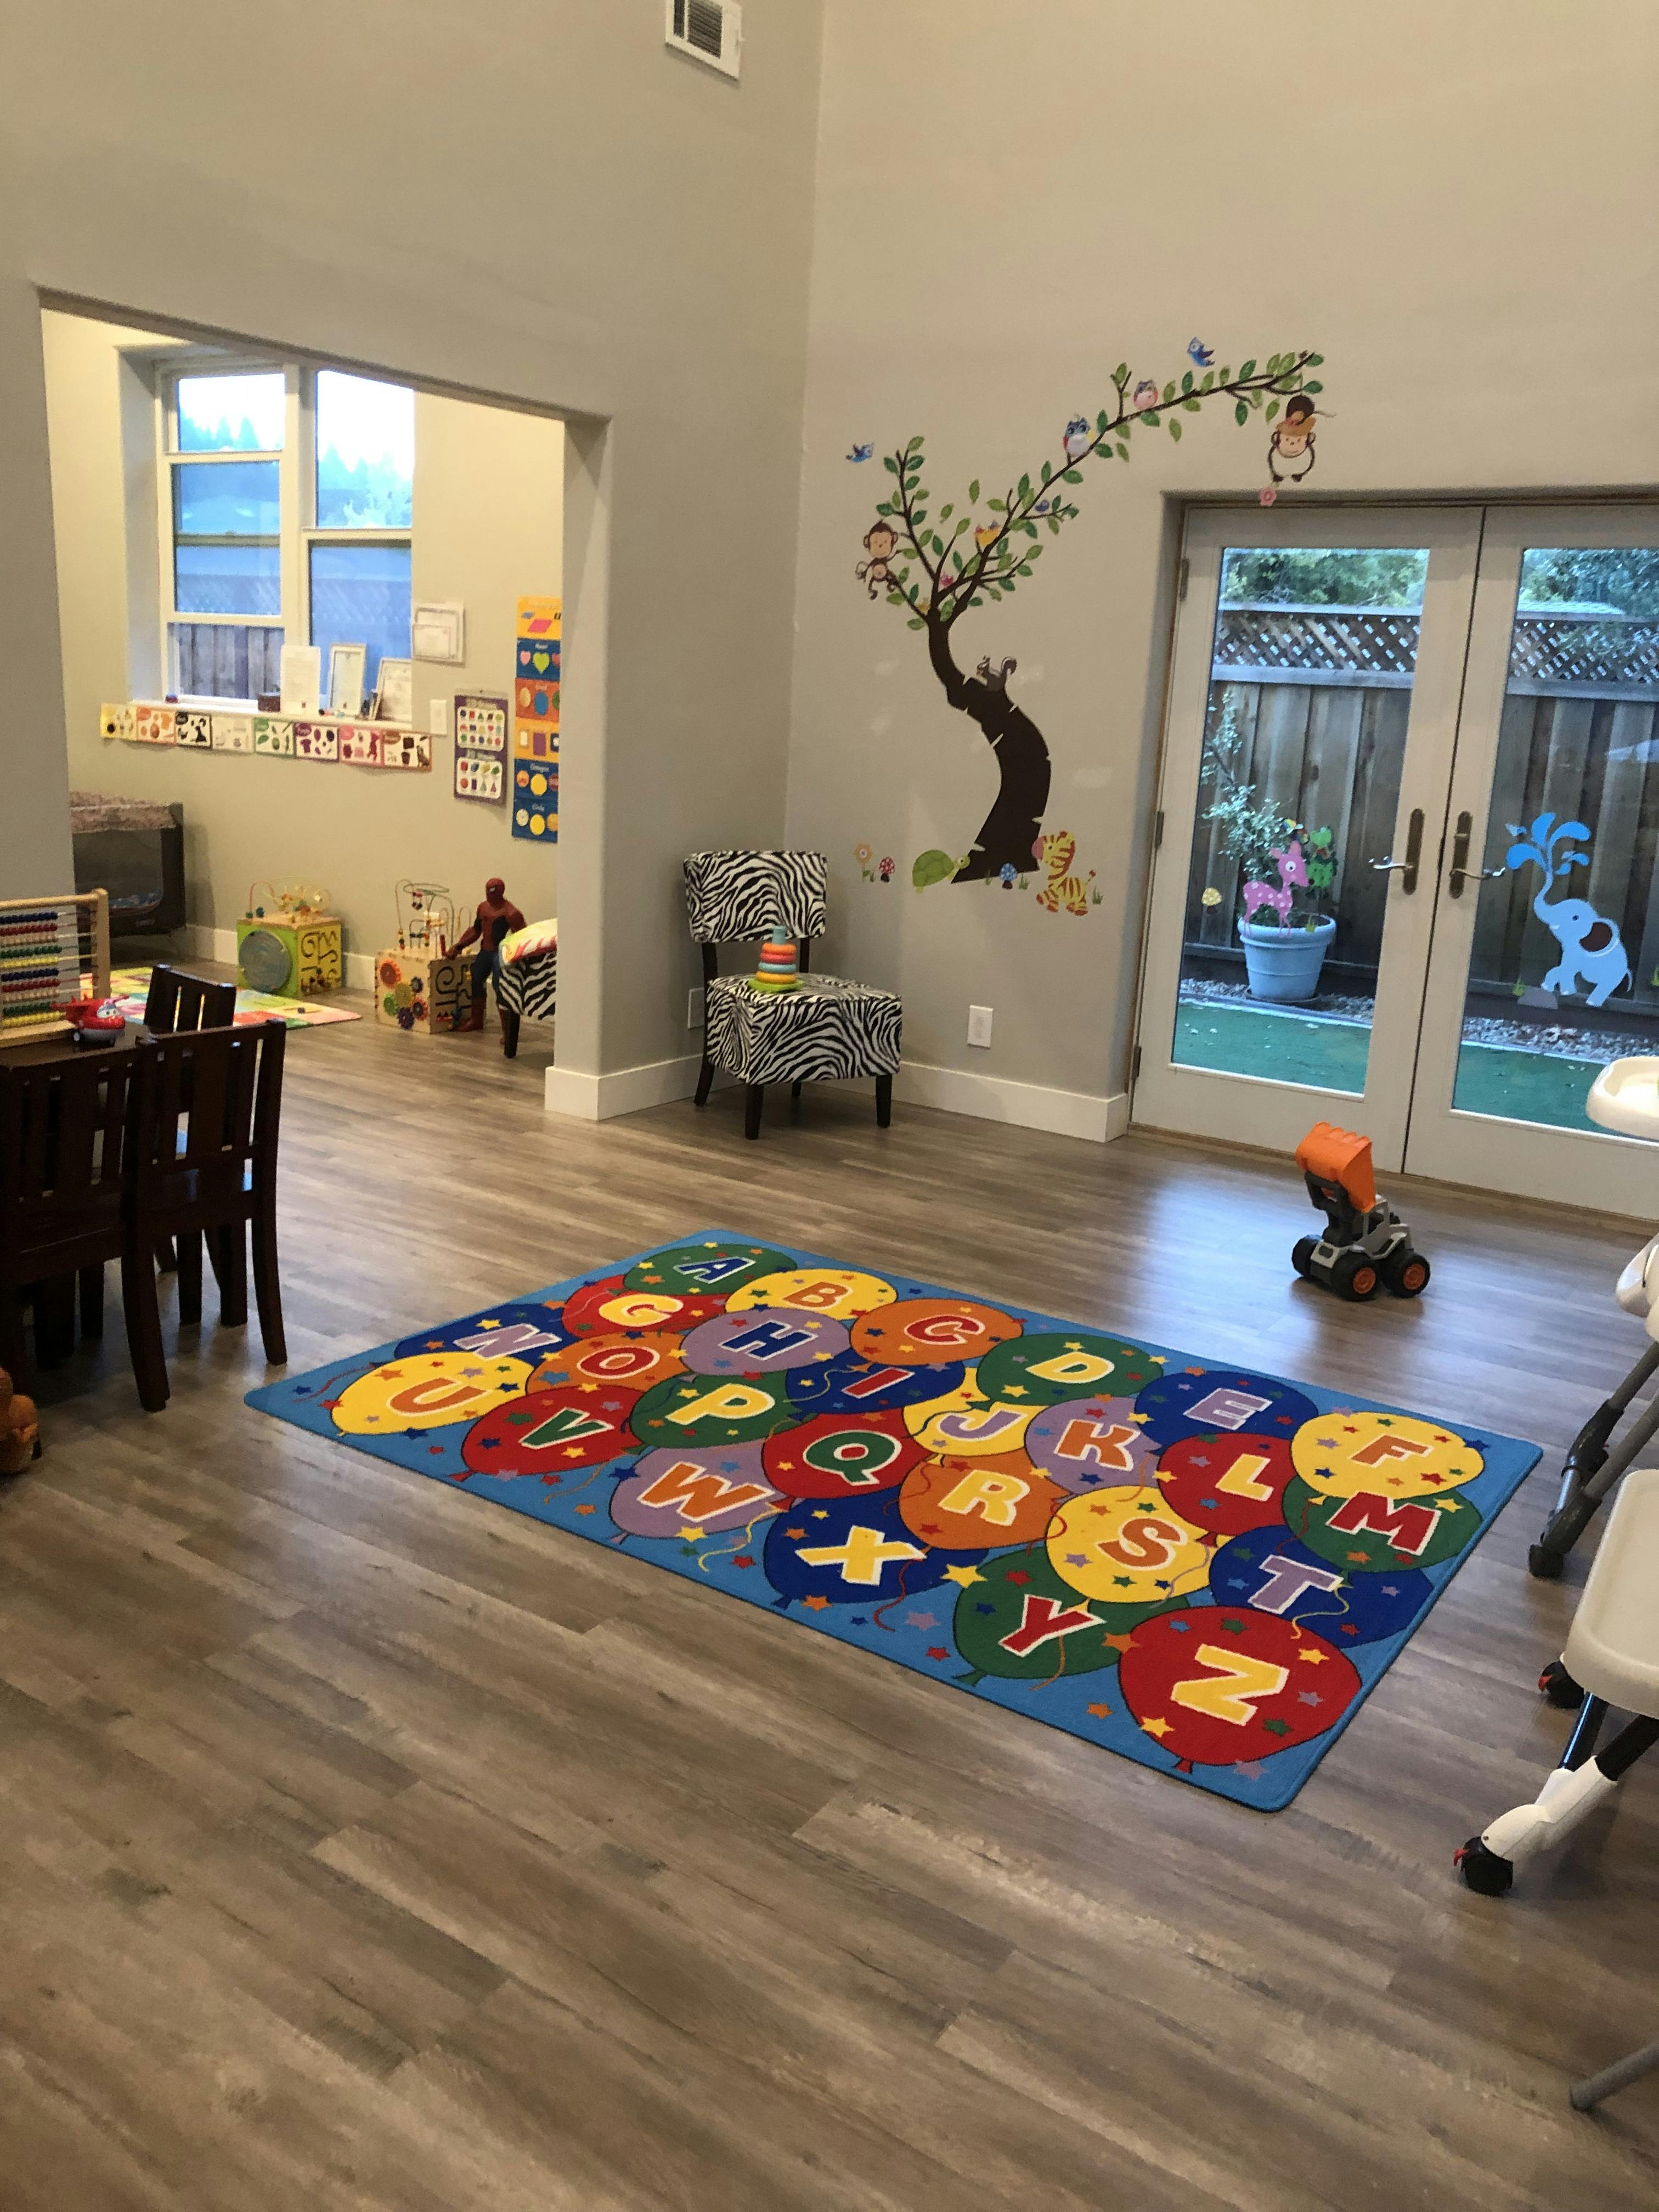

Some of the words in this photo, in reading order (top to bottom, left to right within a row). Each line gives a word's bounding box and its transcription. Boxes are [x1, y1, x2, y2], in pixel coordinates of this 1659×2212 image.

[453, 1323, 563, 1361] N
[575, 1345, 661, 1380] O
[665, 1383, 776, 1426] P
[802, 1429, 902, 1487] Q
[938, 1469, 1032, 1527] R
[1094, 1517, 1189, 1571] S
[1248, 1554, 1345, 1615] T
[598, 1294, 685, 1328] G
[718, 1320, 820, 1362] H
[840, 1365, 916, 1399] I
[939, 1408, 1027, 1441] J
[1053, 1418, 1141, 1472] K
[1215, 1454, 1275, 1502] L
[1328, 1491, 1442, 1556] M
[673, 1256, 755, 1283] A
[782, 1279, 854, 1311] B
[903, 1314, 986, 1345] C
[1026, 1352, 1116, 1384] D
[1182, 1387, 1274, 1430] E
[1350, 1434, 1432, 1468] F
[388, 1378, 486, 1417] U
[519, 1406, 615, 1452] V
[636, 1460, 776, 1522] W
[795, 1525, 927, 1585] X
[999, 1593, 1108, 1657] Y
[1171, 1643, 1289, 1726] Z
